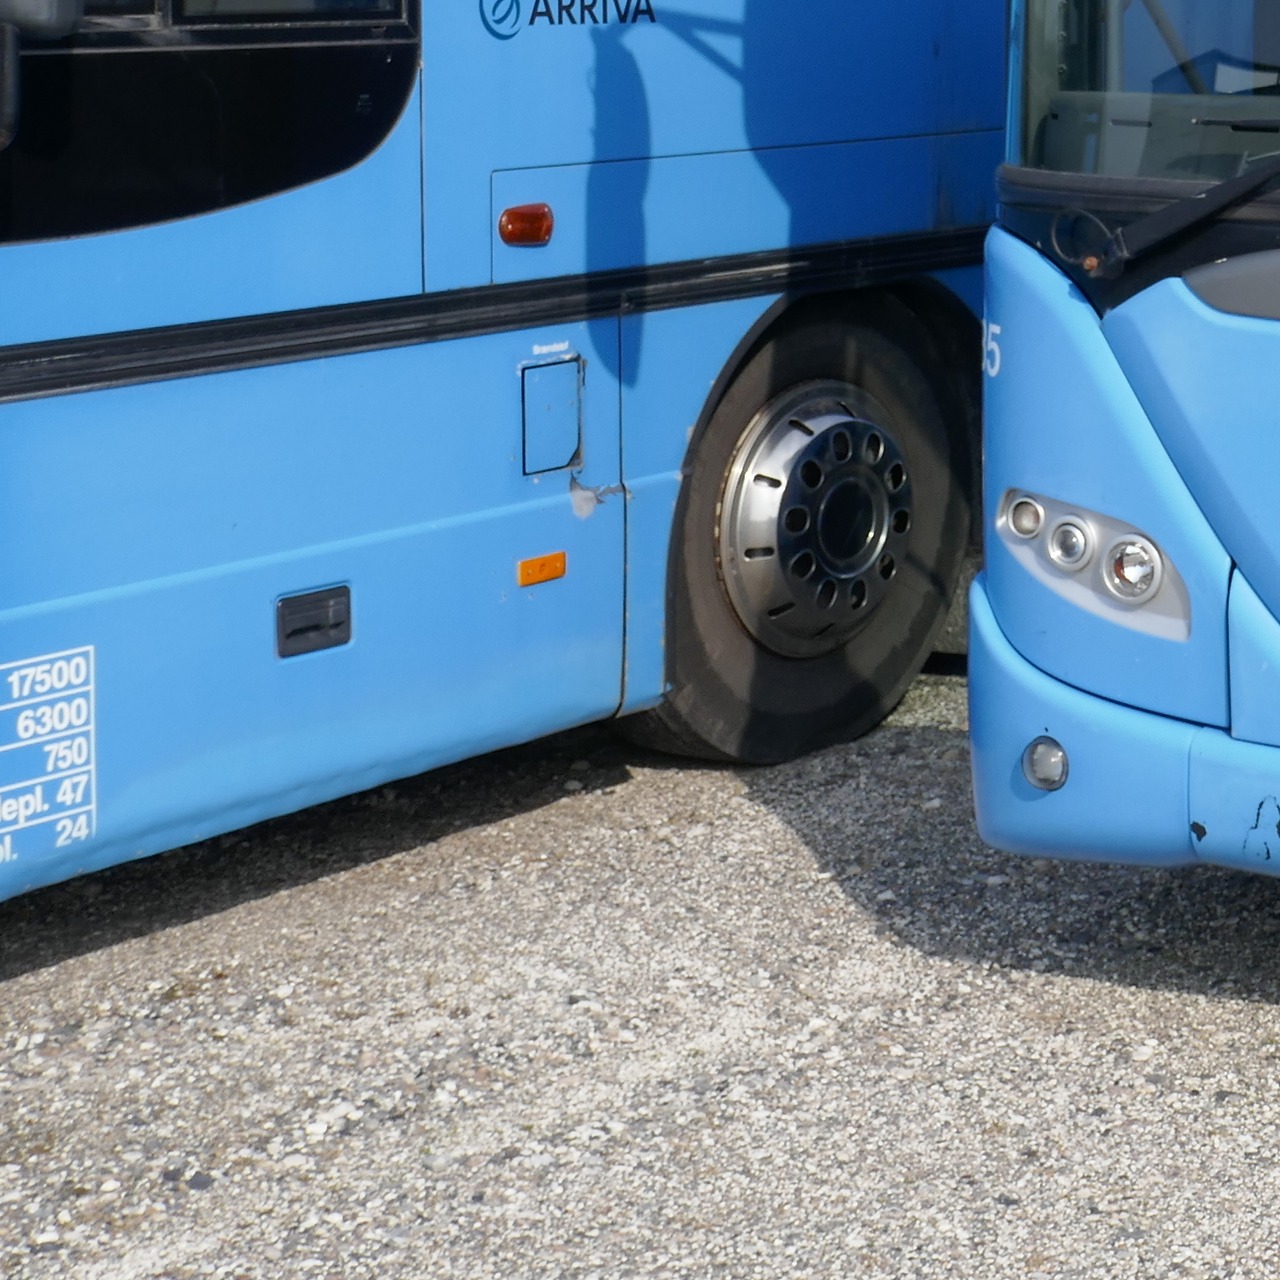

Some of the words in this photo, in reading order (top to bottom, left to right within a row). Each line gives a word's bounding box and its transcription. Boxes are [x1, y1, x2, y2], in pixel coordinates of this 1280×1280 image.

[982, 319, 1002, 377] 5
[7, 655, 88, 699] 17500
[16, 696, 89, 740] 6300
[43, 736, 88, 773] 750
[0, 785, 50, 826] epl.
[55, 773, 90, 806] 47
[55, 813, 89, 848] 24
